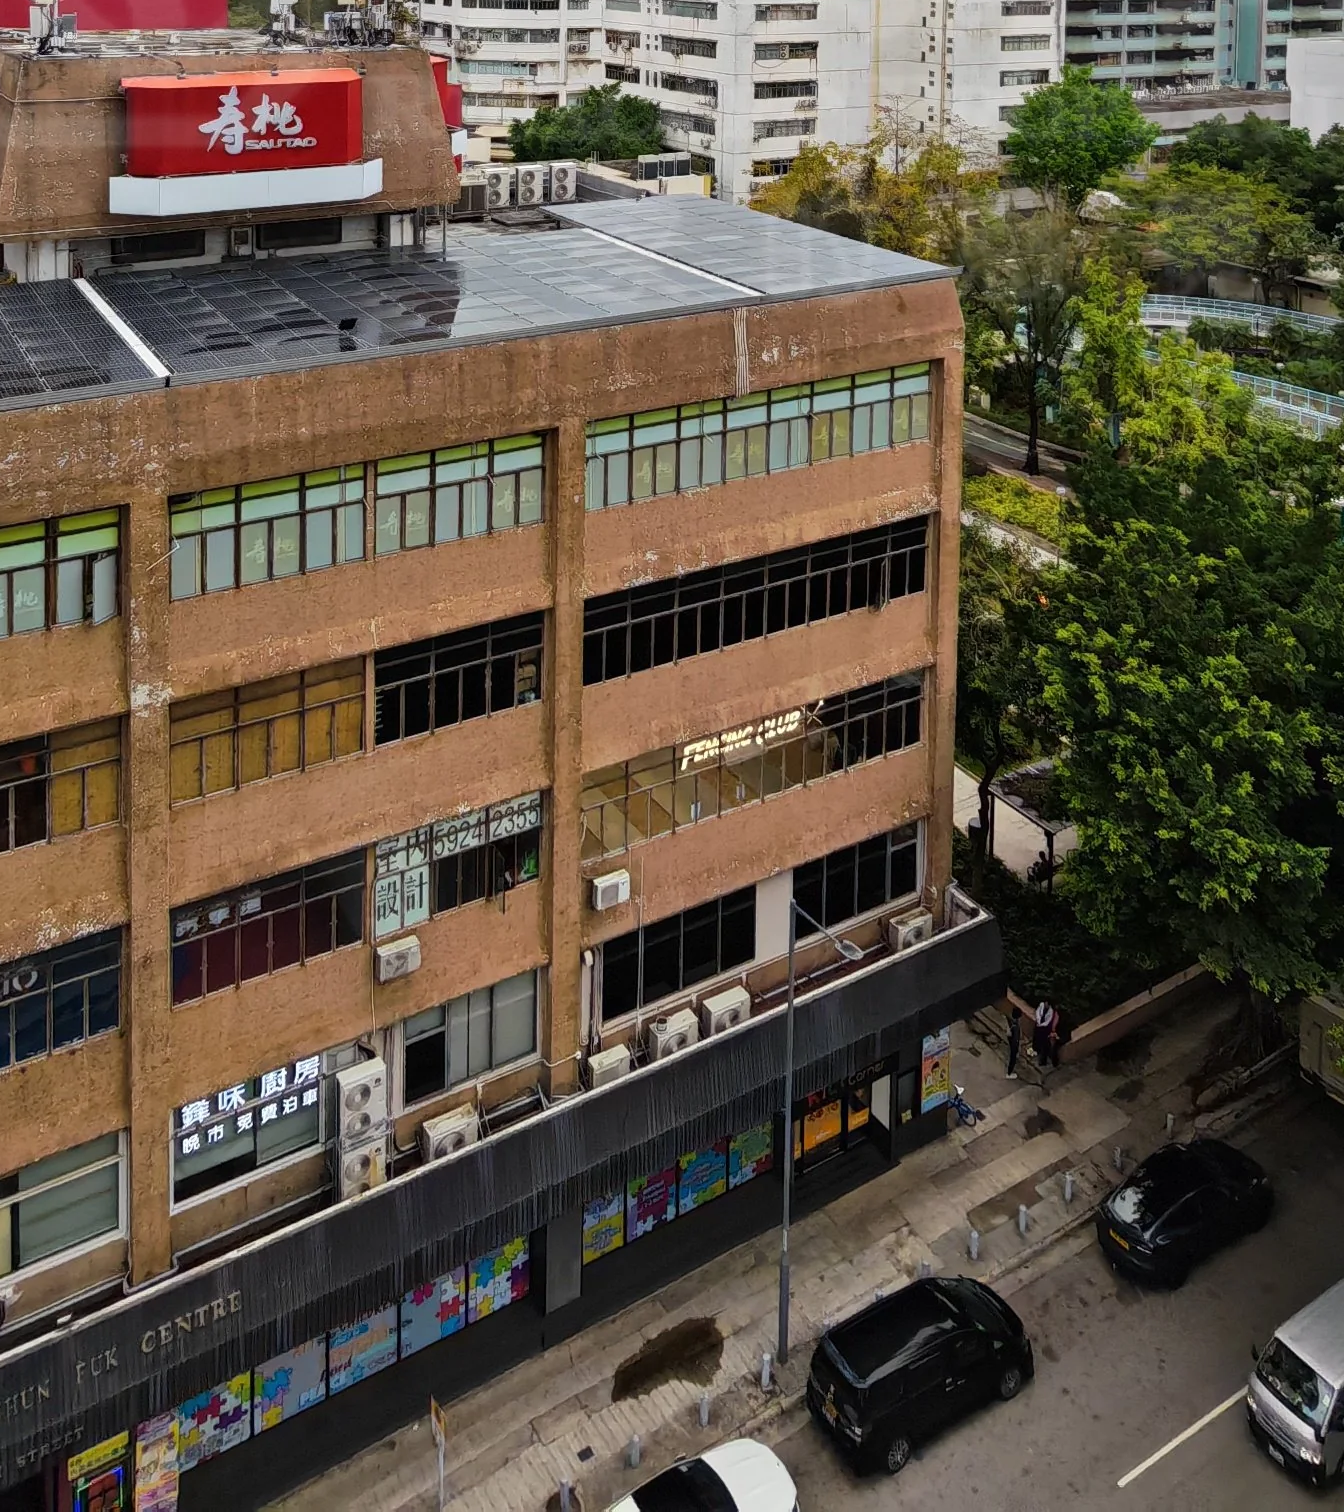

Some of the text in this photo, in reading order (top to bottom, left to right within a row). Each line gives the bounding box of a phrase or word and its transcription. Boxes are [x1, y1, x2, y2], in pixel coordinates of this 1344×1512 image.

[756, 709, 801, 746] CLUB
[434, 816, 484, 857] 5924
[492, 797, 540, 839] 2355
[377, 871, 428, 921] 設計
[76, 1345, 119, 1385] FUK
[141, 1289, 243, 1355] CENTRE
